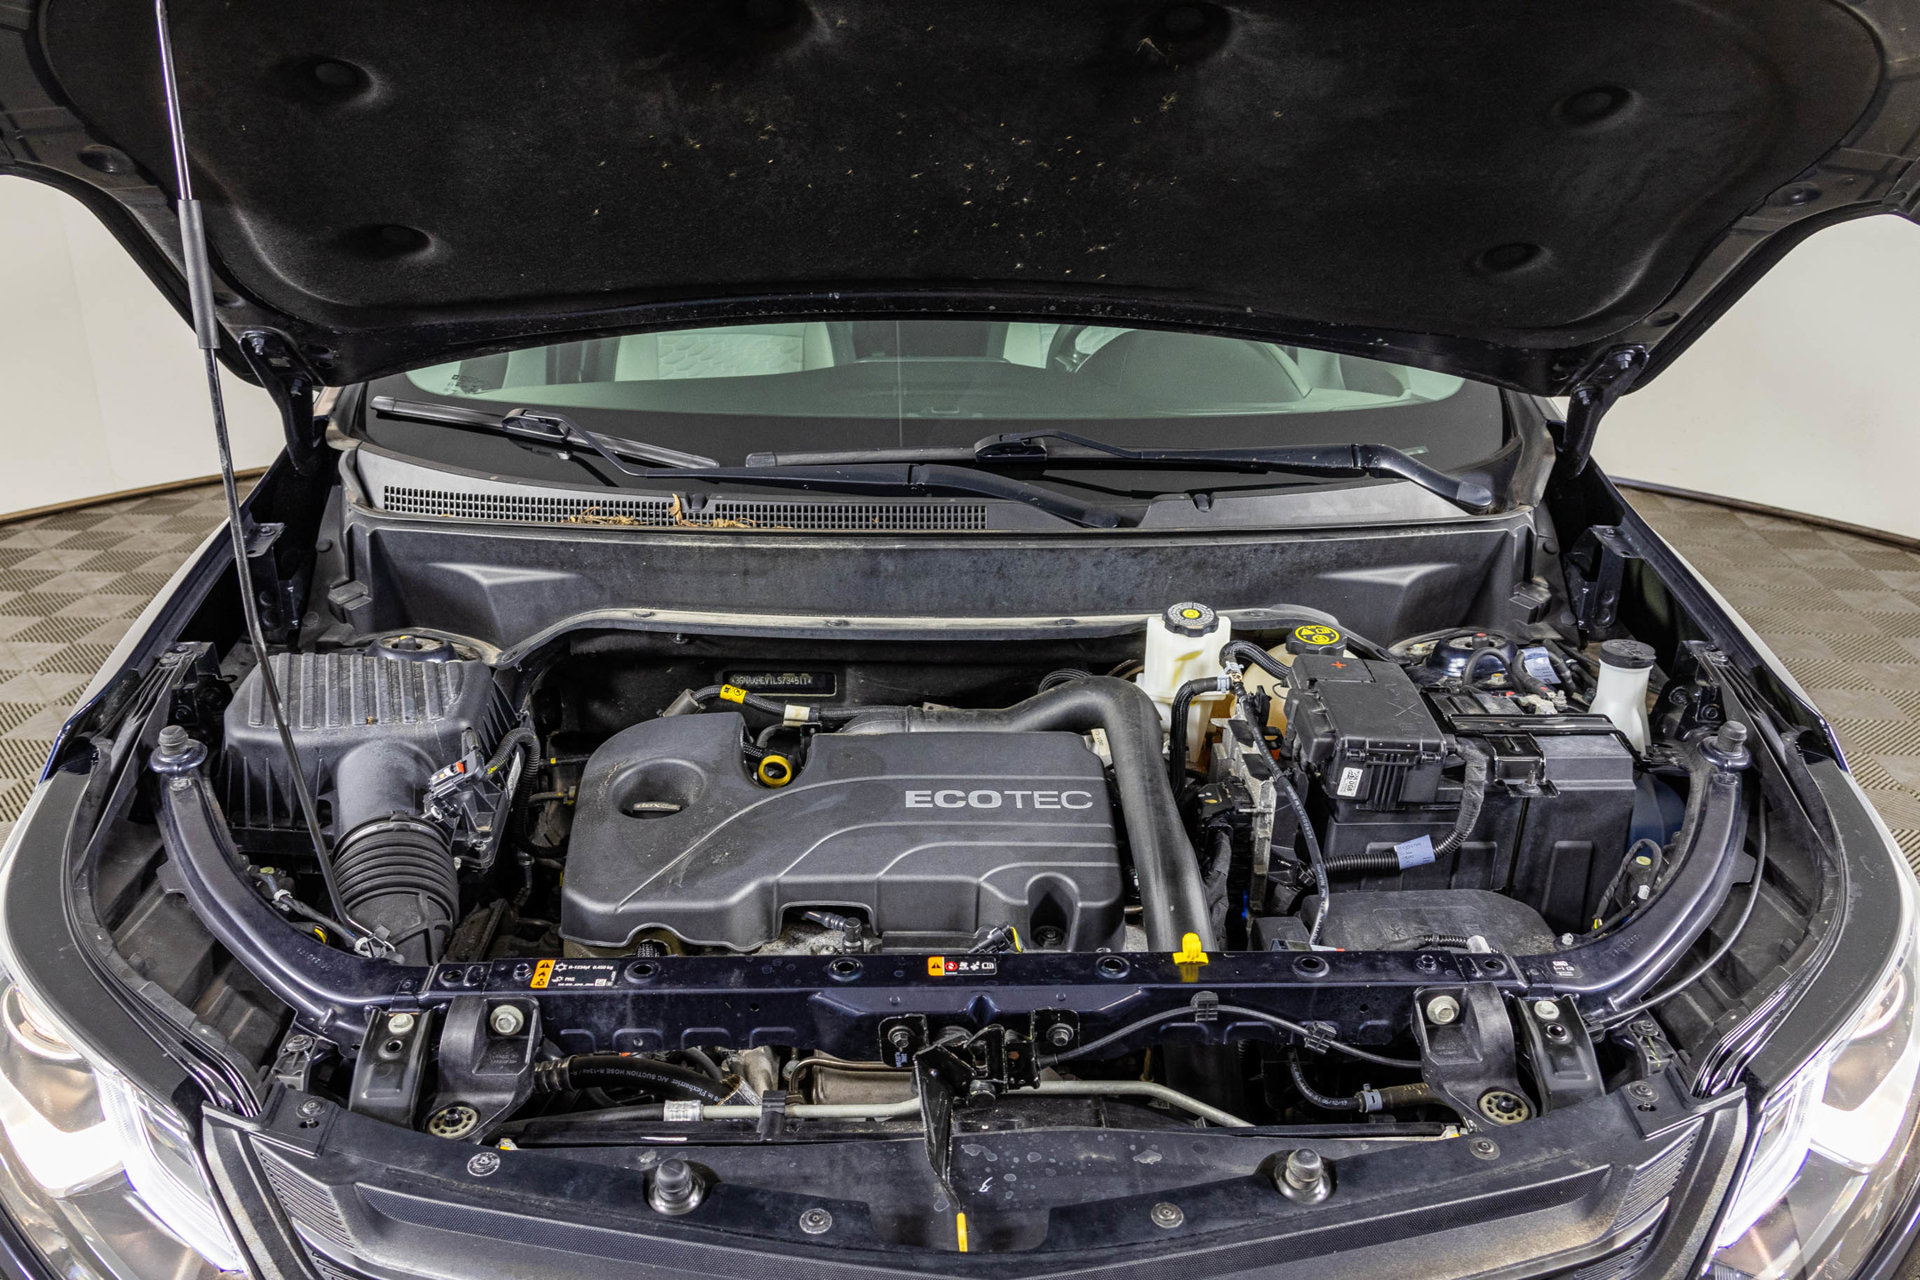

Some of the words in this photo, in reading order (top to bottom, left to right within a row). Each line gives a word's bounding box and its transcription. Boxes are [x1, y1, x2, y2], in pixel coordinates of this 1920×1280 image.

[905, 790, 1094, 809] ECOTEC
[606, 1067, 625, 1075] HOSE
[626, 1069, 656, 1080] SUCTION
[657, 1074, 669, 1083] A/C
[671, 1078, 707, 1097] Flexbarrier
